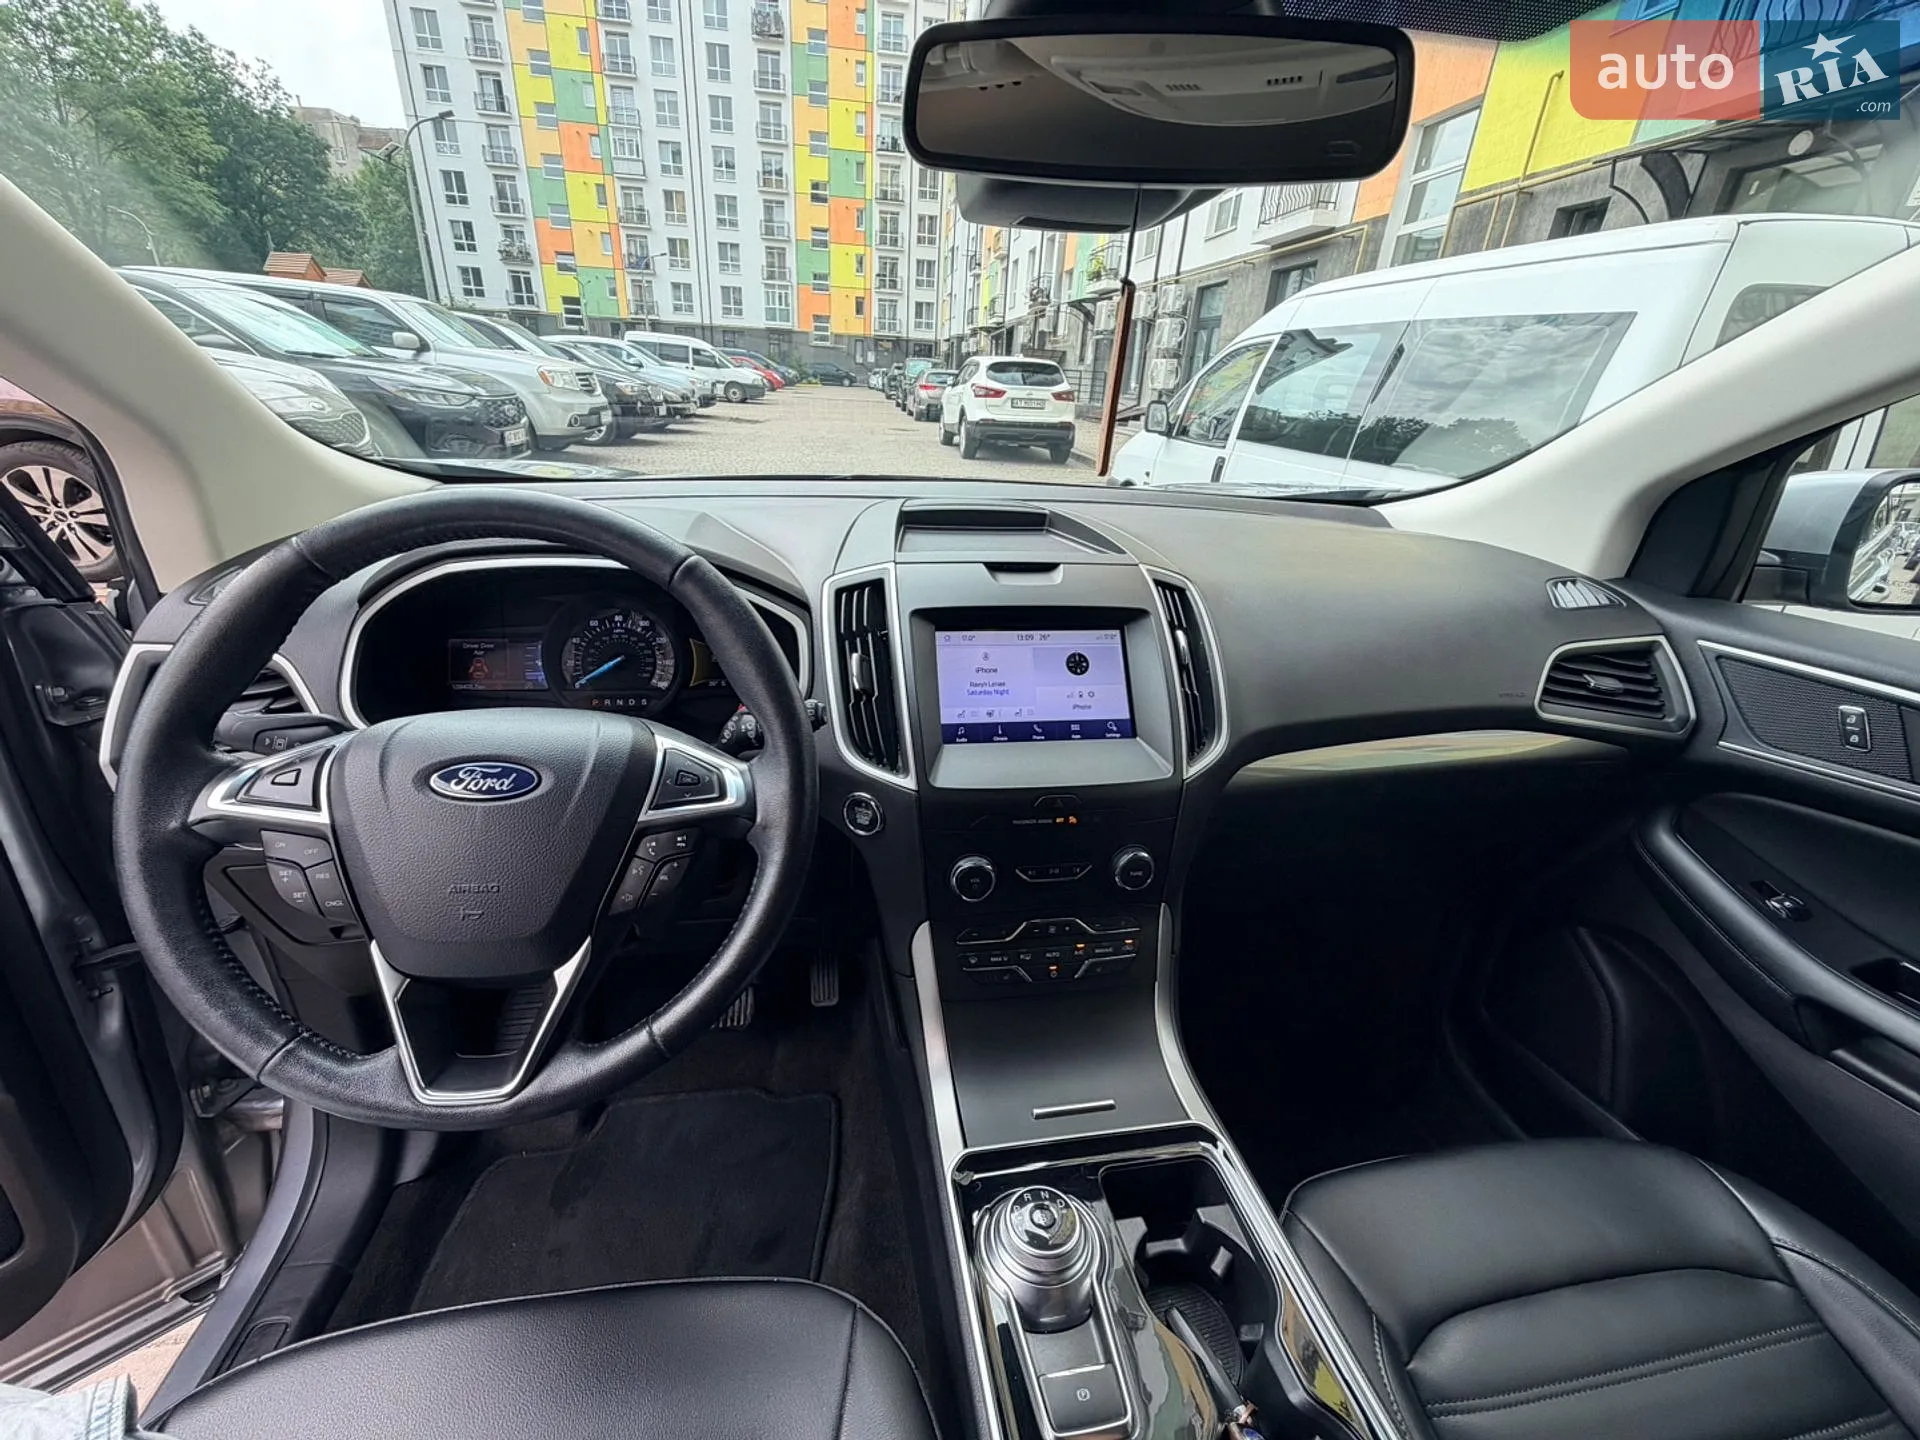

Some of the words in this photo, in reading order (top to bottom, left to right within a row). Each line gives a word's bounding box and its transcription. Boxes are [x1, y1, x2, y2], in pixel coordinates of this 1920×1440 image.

[975, 666, 998, 674] iPhone
[450, 766, 518, 791] Ford
[448, 883, 501, 894] AIRBAG
[1023, 1193, 1032, 1202] R
[1040, 1190, 1050, 1199] N
[1056, 1199, 1066, 1208] D
